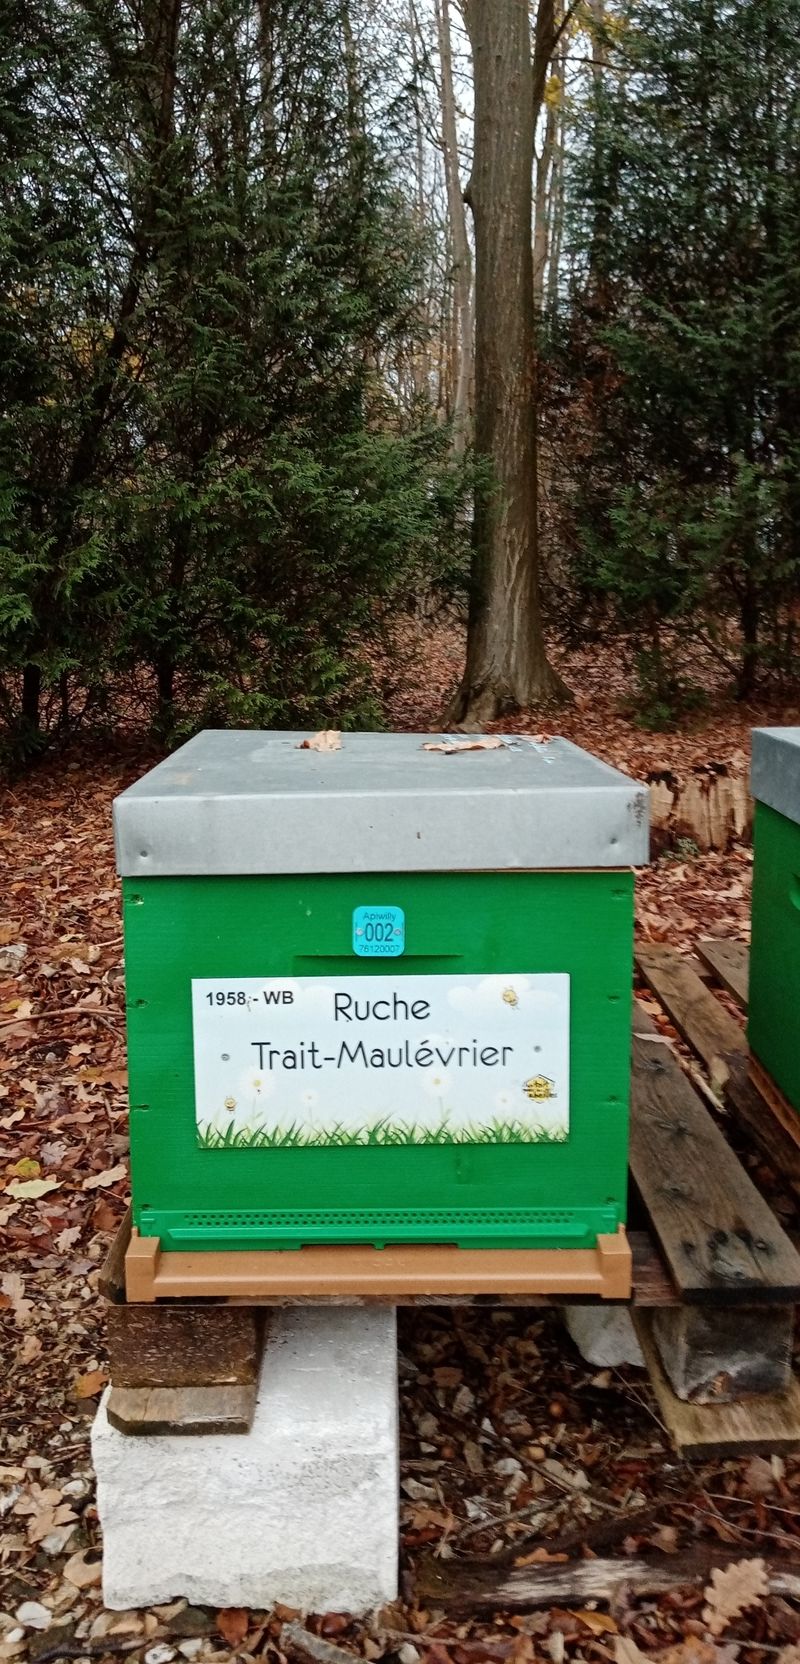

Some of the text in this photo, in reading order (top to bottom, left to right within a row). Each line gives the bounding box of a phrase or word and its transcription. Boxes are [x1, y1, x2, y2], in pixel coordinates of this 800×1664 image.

[365, 923, 393, 942] 002
[206, 992, 246, 1006] 1958
[263, 991, 294, 1005] WB
[333, 992, 431, 1021] Ruche
[251, 1039, 514, 1070] Trait-Maulévrier
